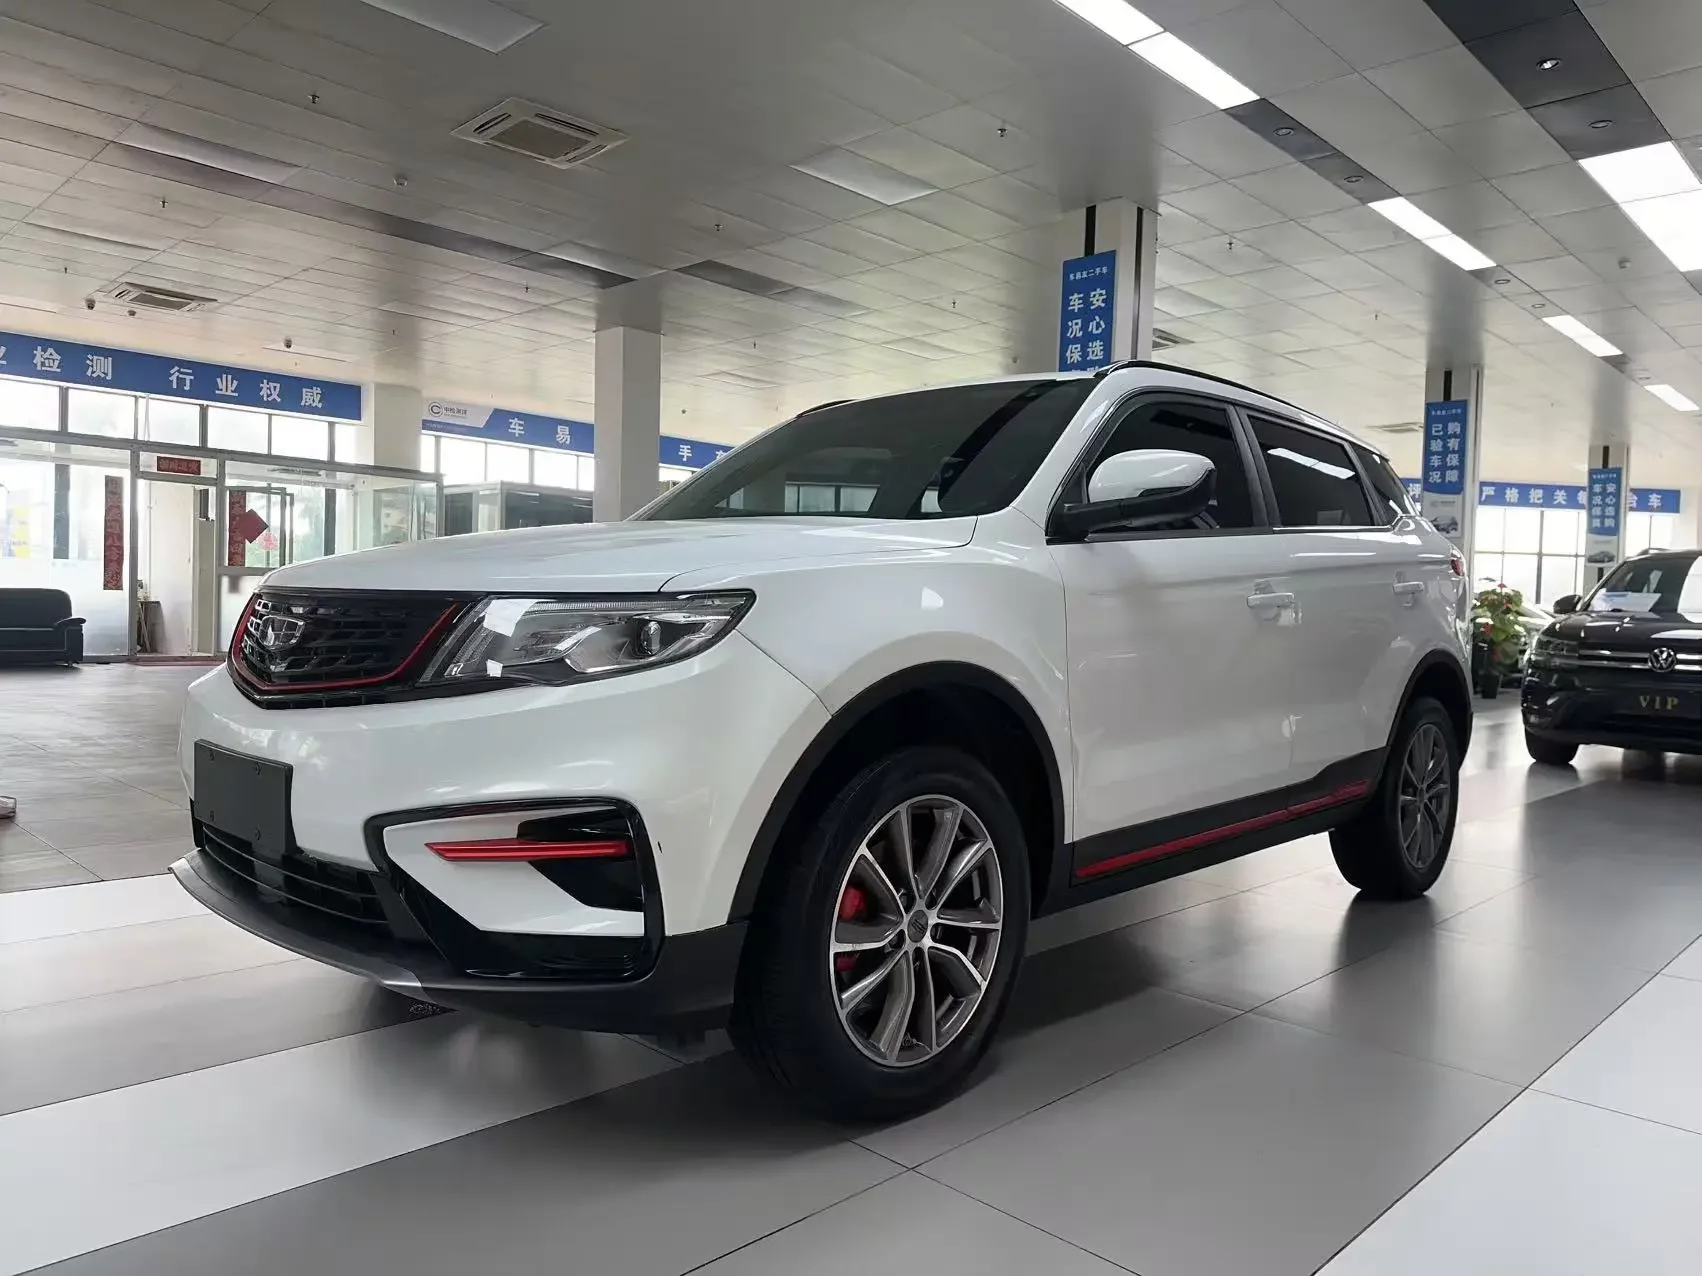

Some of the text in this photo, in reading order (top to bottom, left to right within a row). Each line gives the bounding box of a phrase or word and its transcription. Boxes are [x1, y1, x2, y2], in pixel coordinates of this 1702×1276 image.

[1066, 292, 1085, 371] 车况保
[1087, 288, 1107, 371] 安心选
[169, 366, 323, 408] 行业权威
[1428, 423, 1444, 483] 已验车况
[1445, 421, 1461, 483] 购有保障
[1639, 695, 1679, 711] VIP
